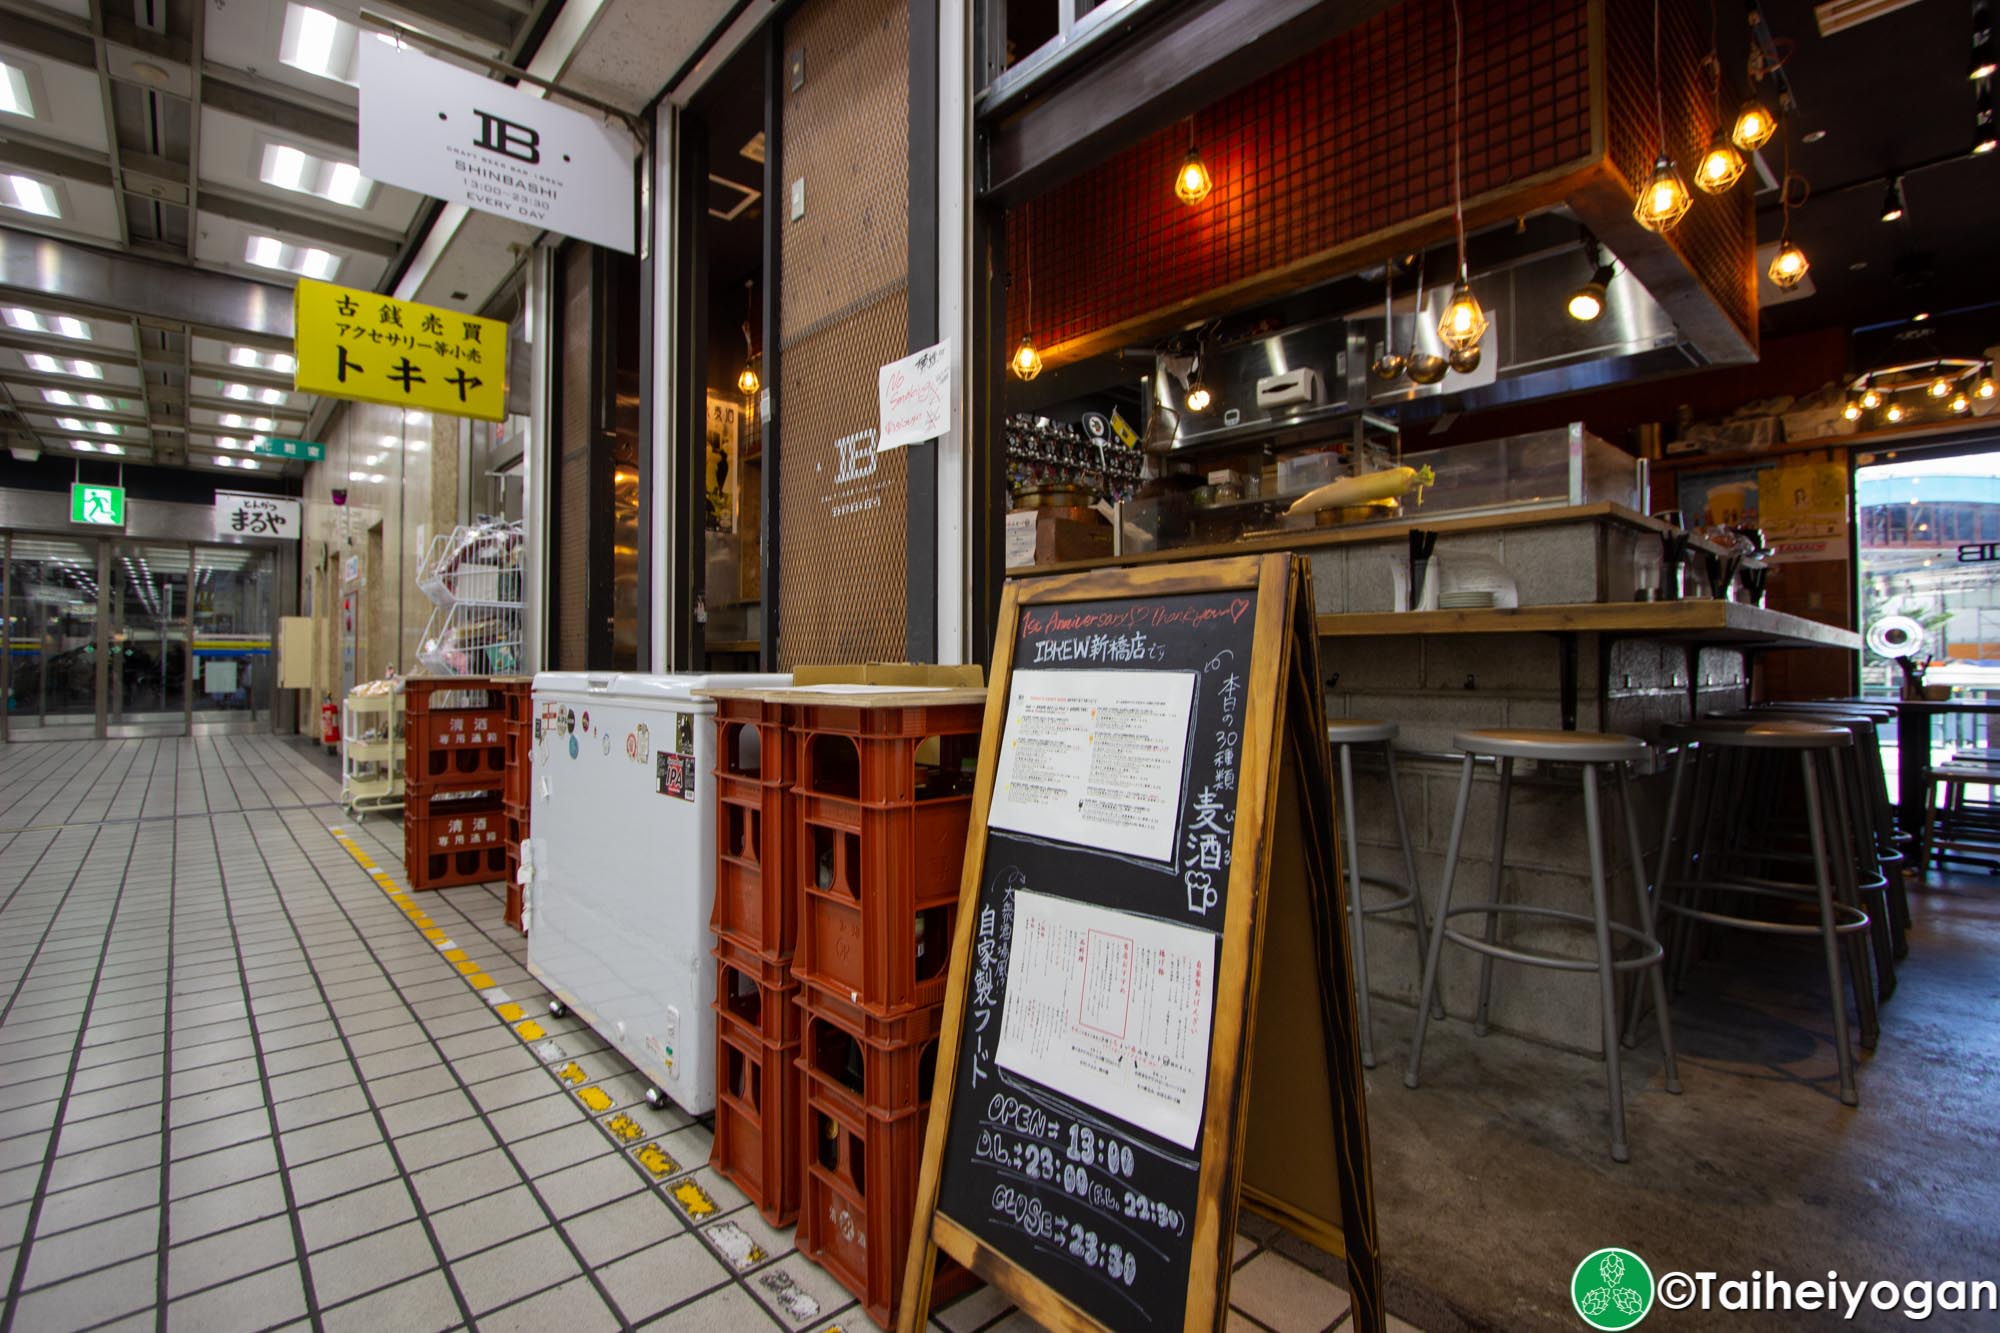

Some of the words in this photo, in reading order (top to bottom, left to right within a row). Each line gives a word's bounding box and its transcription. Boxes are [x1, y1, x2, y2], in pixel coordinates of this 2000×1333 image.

[455, 159, 557, 200] SHINBASHI
[467, 191, 511, 211] EVERY
[519, 206, 545, 220] DAY
[336, 294, 482, 344] 古銭売買
[336, 322, 482, 364] アクセサリー等小売
[337, 345, 483, 402] トキヤ
[232, 507, 286, 534] まるや
[450, 718, 487, 731] 清酒
[666, 766, 683, 788] IPA
[449, 817, 487, 833] 清酒
[1185, 785, 1229, 871] 麦酒
[971, 904, 998, 1089] 自家製フード
[988, 1093, 1046, 1138] OPEN
[1066, 1123, 1134, 1177] 13:00
[1025, 1143, 1089, 1196] 23:00
[992, 1184, 1053, 1238] CLOSE
[1068, 1223, 1136, 1287] 23:30
